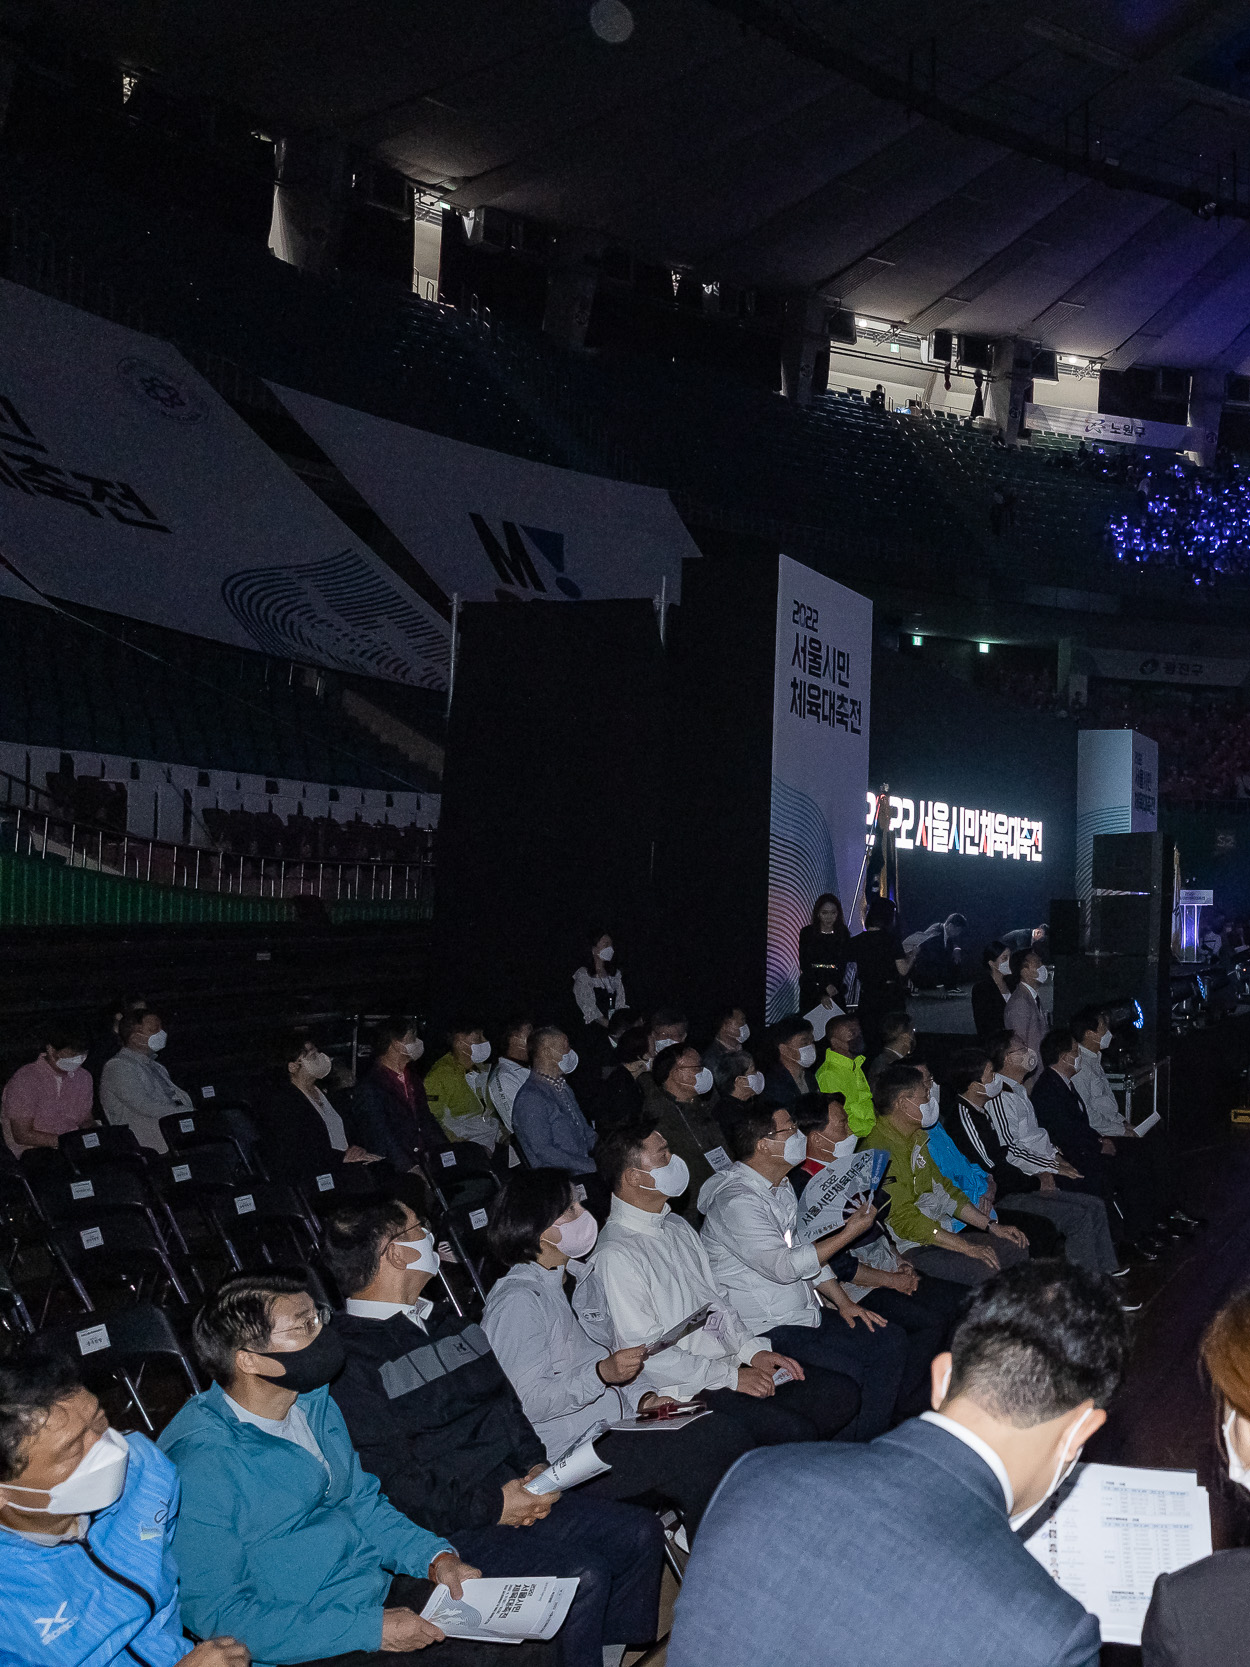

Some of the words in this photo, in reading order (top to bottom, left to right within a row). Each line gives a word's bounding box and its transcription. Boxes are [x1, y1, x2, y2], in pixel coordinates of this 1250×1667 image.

[1109, 422, 1146, 438] 노원구
[792, 600, 819, 633] 2022
[791, 632, 850, 699] 서울시민
[1163, 661, 1204, 676] 광진구
[789, 677, 862, 736] 체육대축전
[801, 1152, 873, 1227] 서울시민체육대축전
[819, 1174, 839, 1192] 2022
[511, 1583, 530, 1613] 서울시민
